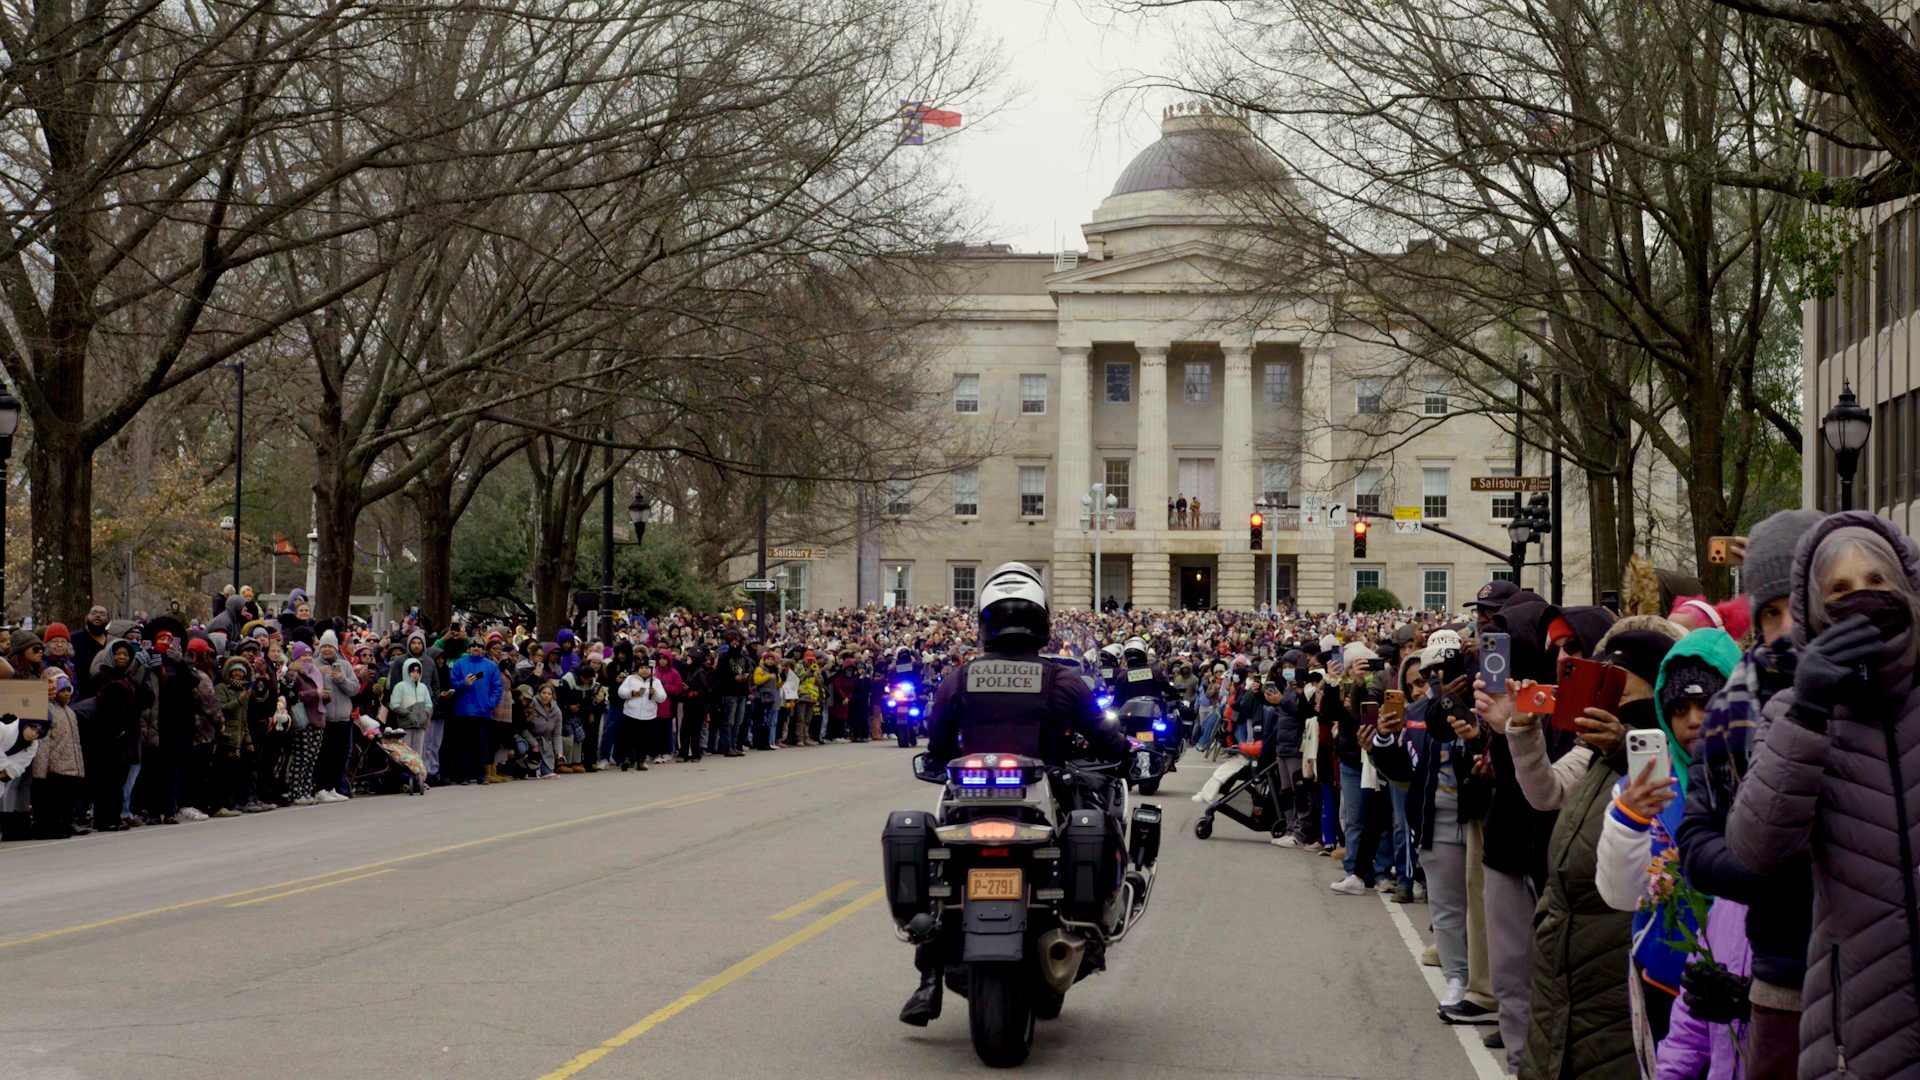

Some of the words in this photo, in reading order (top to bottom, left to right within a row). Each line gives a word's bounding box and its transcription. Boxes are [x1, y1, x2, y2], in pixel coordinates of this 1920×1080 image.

[1480, 478, 1526, 490] Salisbury
[774, 548, 810, 558] Salisbury
[970, 664, 1040, 676] RALEIGH
[976, 676, 1032, 688] POLICE
[974, 880, 1013, 894] P-2791
